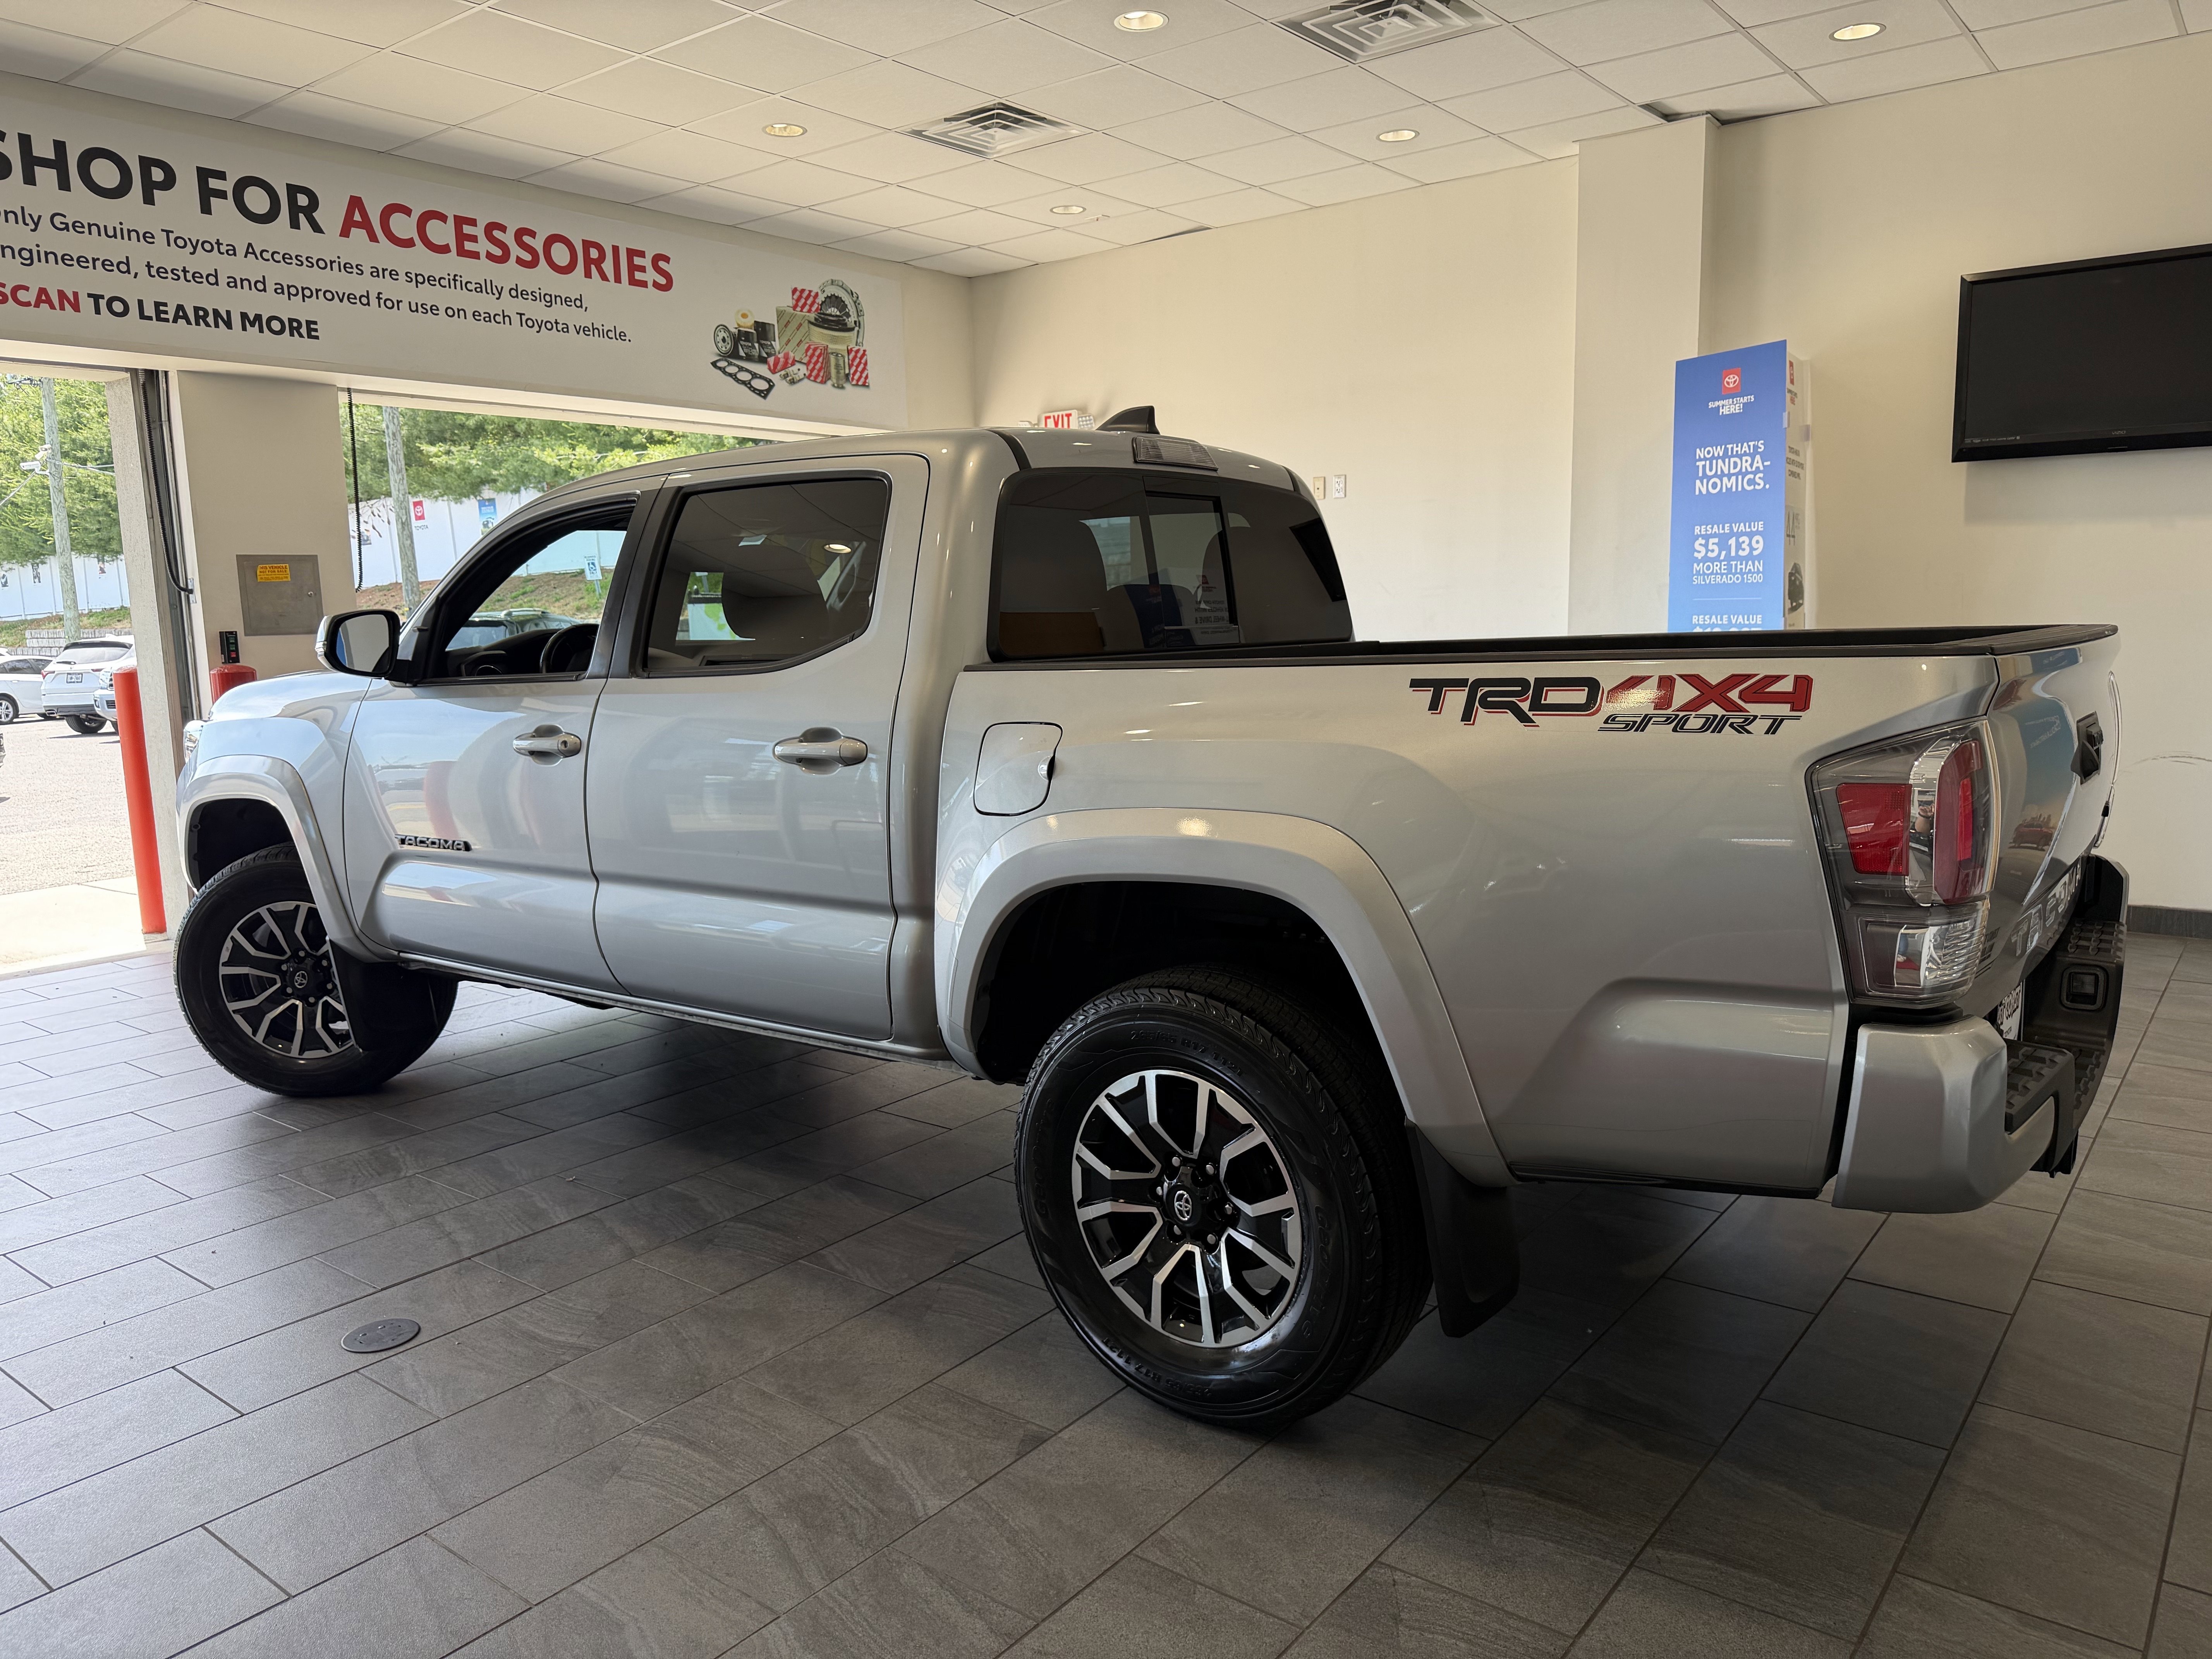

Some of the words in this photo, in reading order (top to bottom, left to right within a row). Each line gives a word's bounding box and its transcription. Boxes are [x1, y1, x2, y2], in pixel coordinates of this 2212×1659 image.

[0, 130, 177, 206] HOP
[196, 166, 325, 235] FOR
[339, 195, 674, 292] ACCESSORIES
[0, 206, 42, 232] nly
[50, 212, 155, 244] Genuine
[161, 229, 237, 257] Toyota
[244, 242, 364, 277] Accessories
[370, 263, 399, 282] are
[405, 270, 504, 301] specifically
[508, 283, 588, 312] designed,
[0, 244, 139, 278] ngineered,
[145, 261, 219, 287] tested
[226, 273, 267, 293] and
[274, 280, 371, 308] approved
[376, 291, 403, 311] for
[408, 301, 440, 316] use
[445, 306, 467, 319] on
[472, 309, 512, 326] each
[516, 312, 570, 334] Toyota
[574, 322, 632, 342] vehicle.
[0, 282, 81, 313] SCAN
[87, 292, 130, 318] TO
[137, 299, 233, 330] LEARN
[240, 311, 320, 340] MORE
[1708, 398, 1733, 408] SUMMER
[1733, 395, 1754, 404] STARTS
[1719, 404, 1743, 415] HERE!
[1696, 445, 1724, 459] NOW
[1726, 440, 1764, 455] THAT'S
[1696, 455, 1771, 477] TUNDRA-
[1695, 473, 1769, 495] NOMICS.
[1694, 524, 1730, 535] RESALE
[1732, 521, 1764, 532] VALUE
[1693, 535, 1764, 560] $5,139
[1693, 562, 1727, 574] MORE
[1730, 560, 1763, 572] THAN
[1693, 574, 1741, 584] SILVERADO
[1743, 574, 1763, 583] 1500
[1692, 615, 1728, 624] RESALE
[1731, 615, 1762, 624] VALUE
[1409, 677, 1604, 727] TRD
[1604, 673, 1813, 715] 4X4
[1598, 713, 1803, 735] SPORT
[395, 834, 466, 851] TACOMA
[2010, 861, 2082, 957] TACOMA
